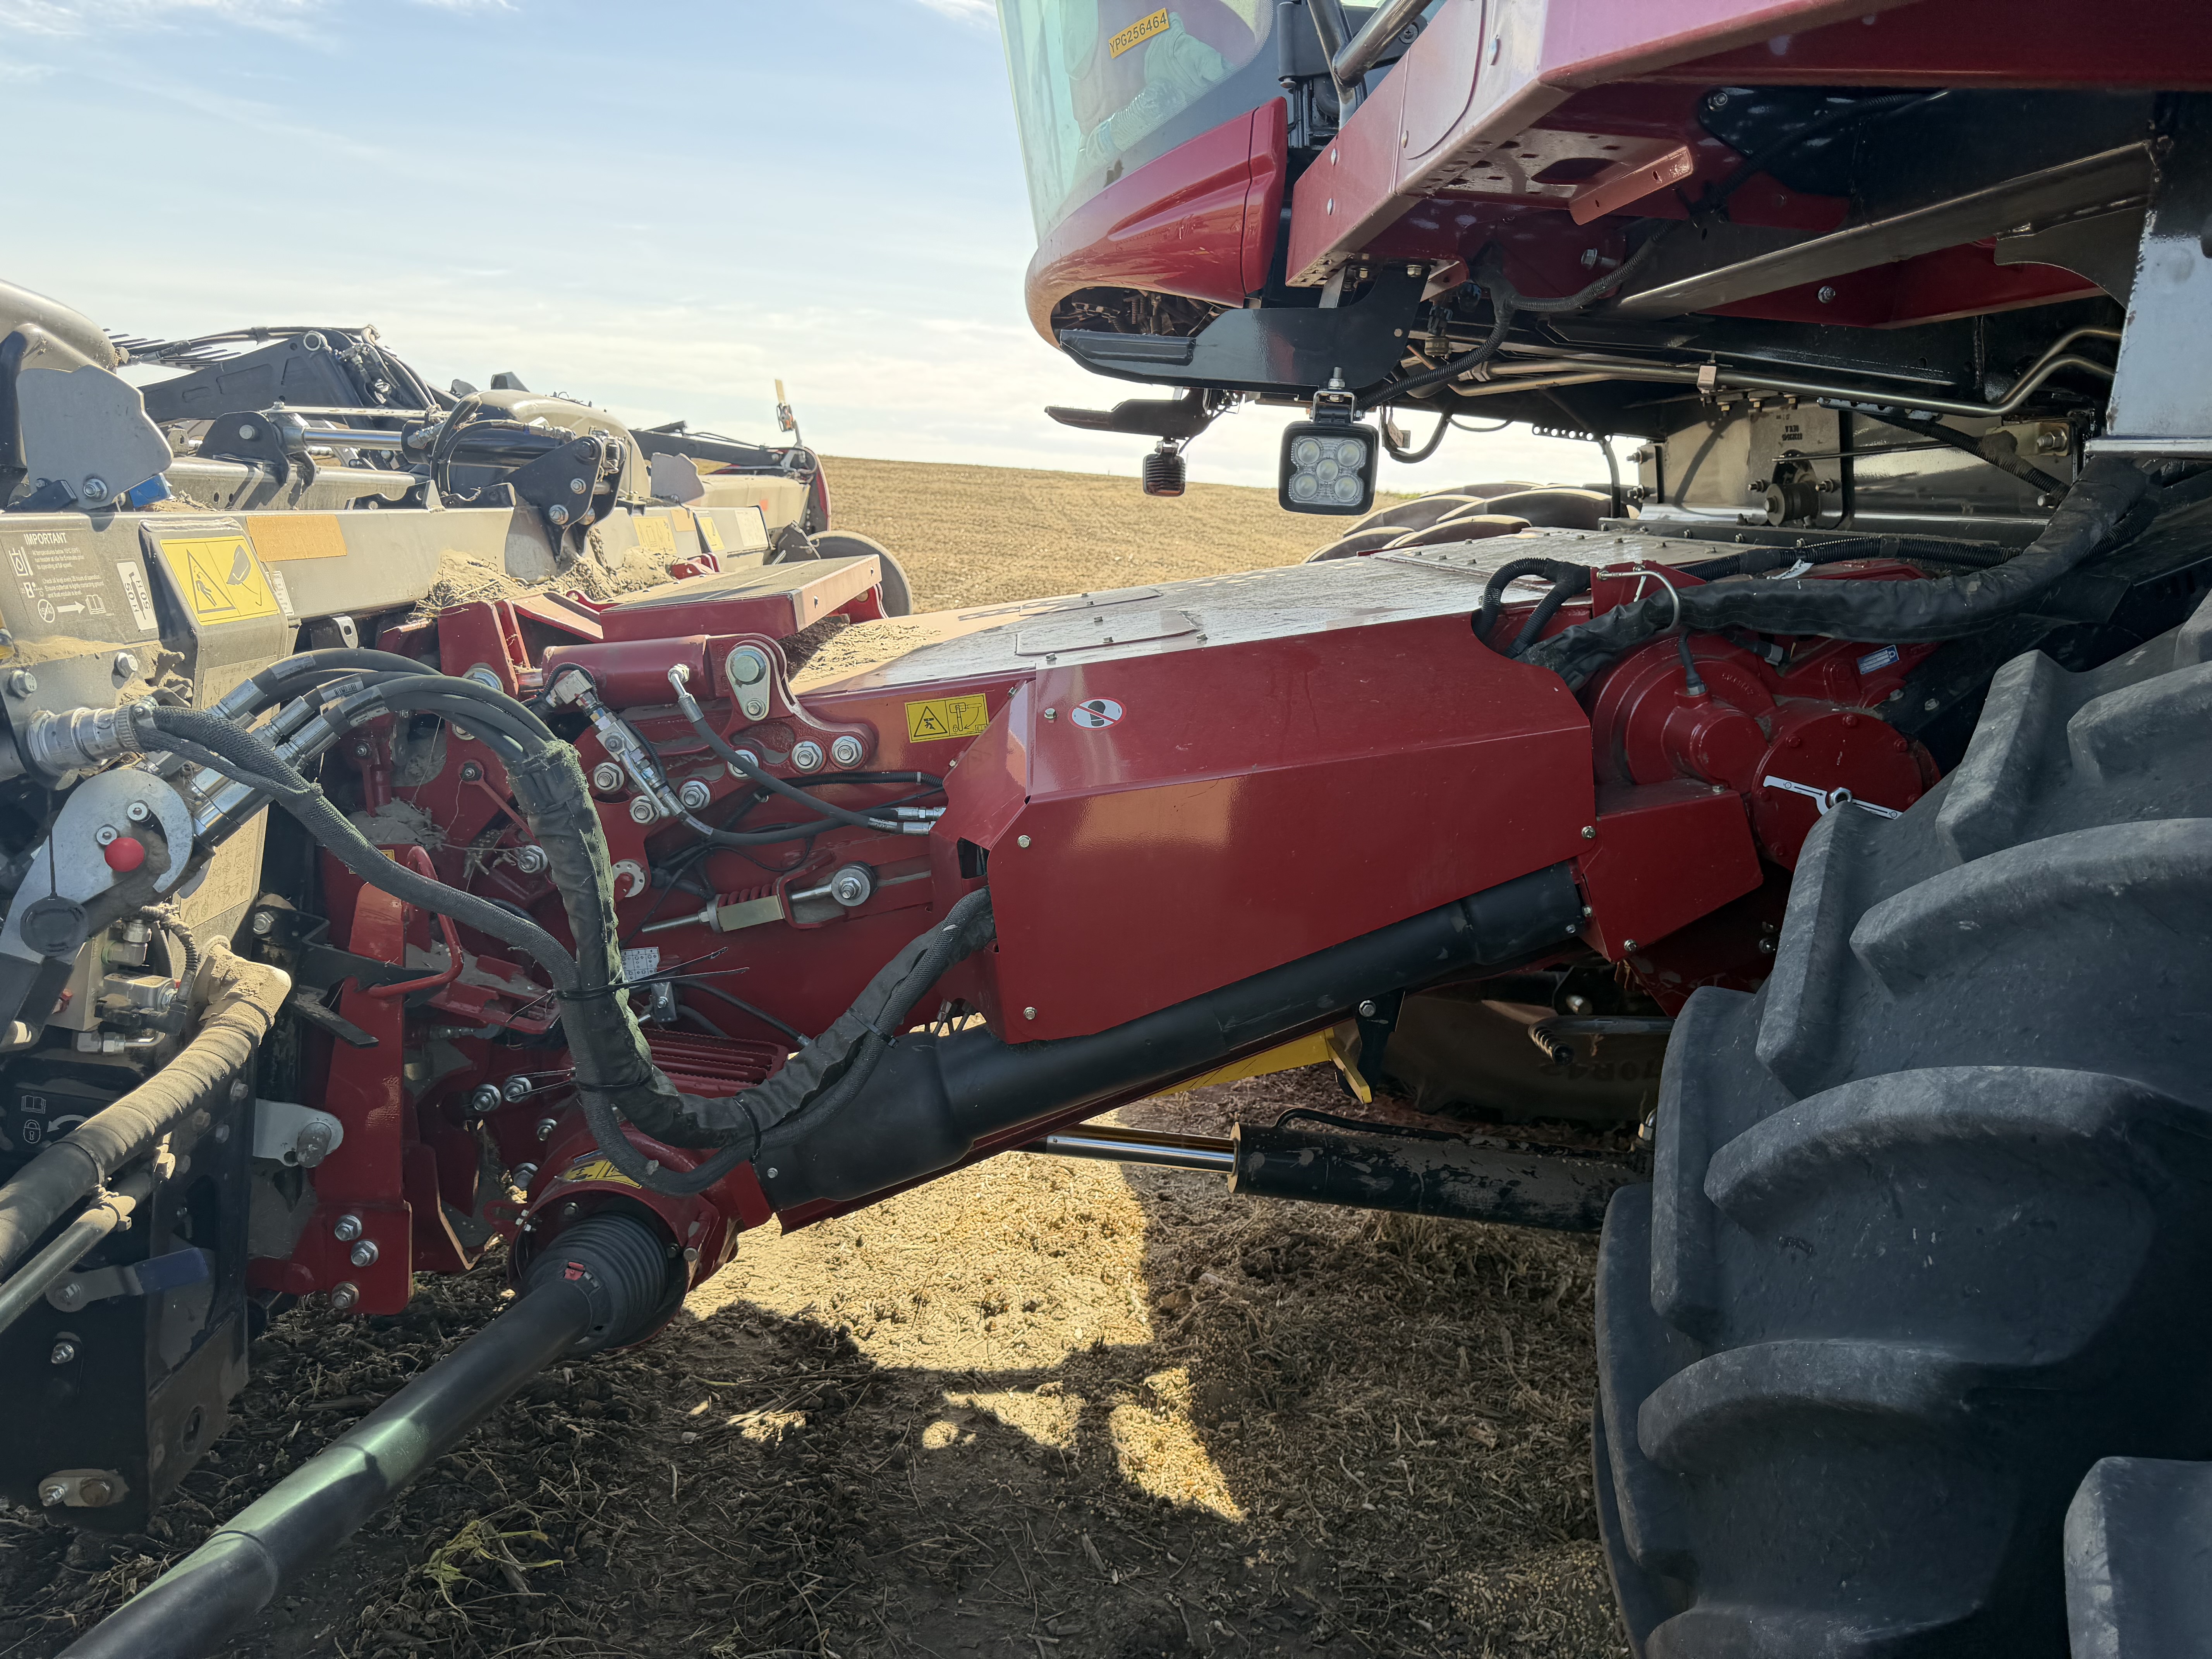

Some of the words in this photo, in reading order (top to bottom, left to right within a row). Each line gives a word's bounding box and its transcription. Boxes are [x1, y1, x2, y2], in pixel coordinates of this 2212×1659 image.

[1109, 12, 1167, 53] YPG256464
[24, 532, 67, 545] IMPORTANT
[125, 582, 135, 601] 50
[140, 592, 151, 609] 50
